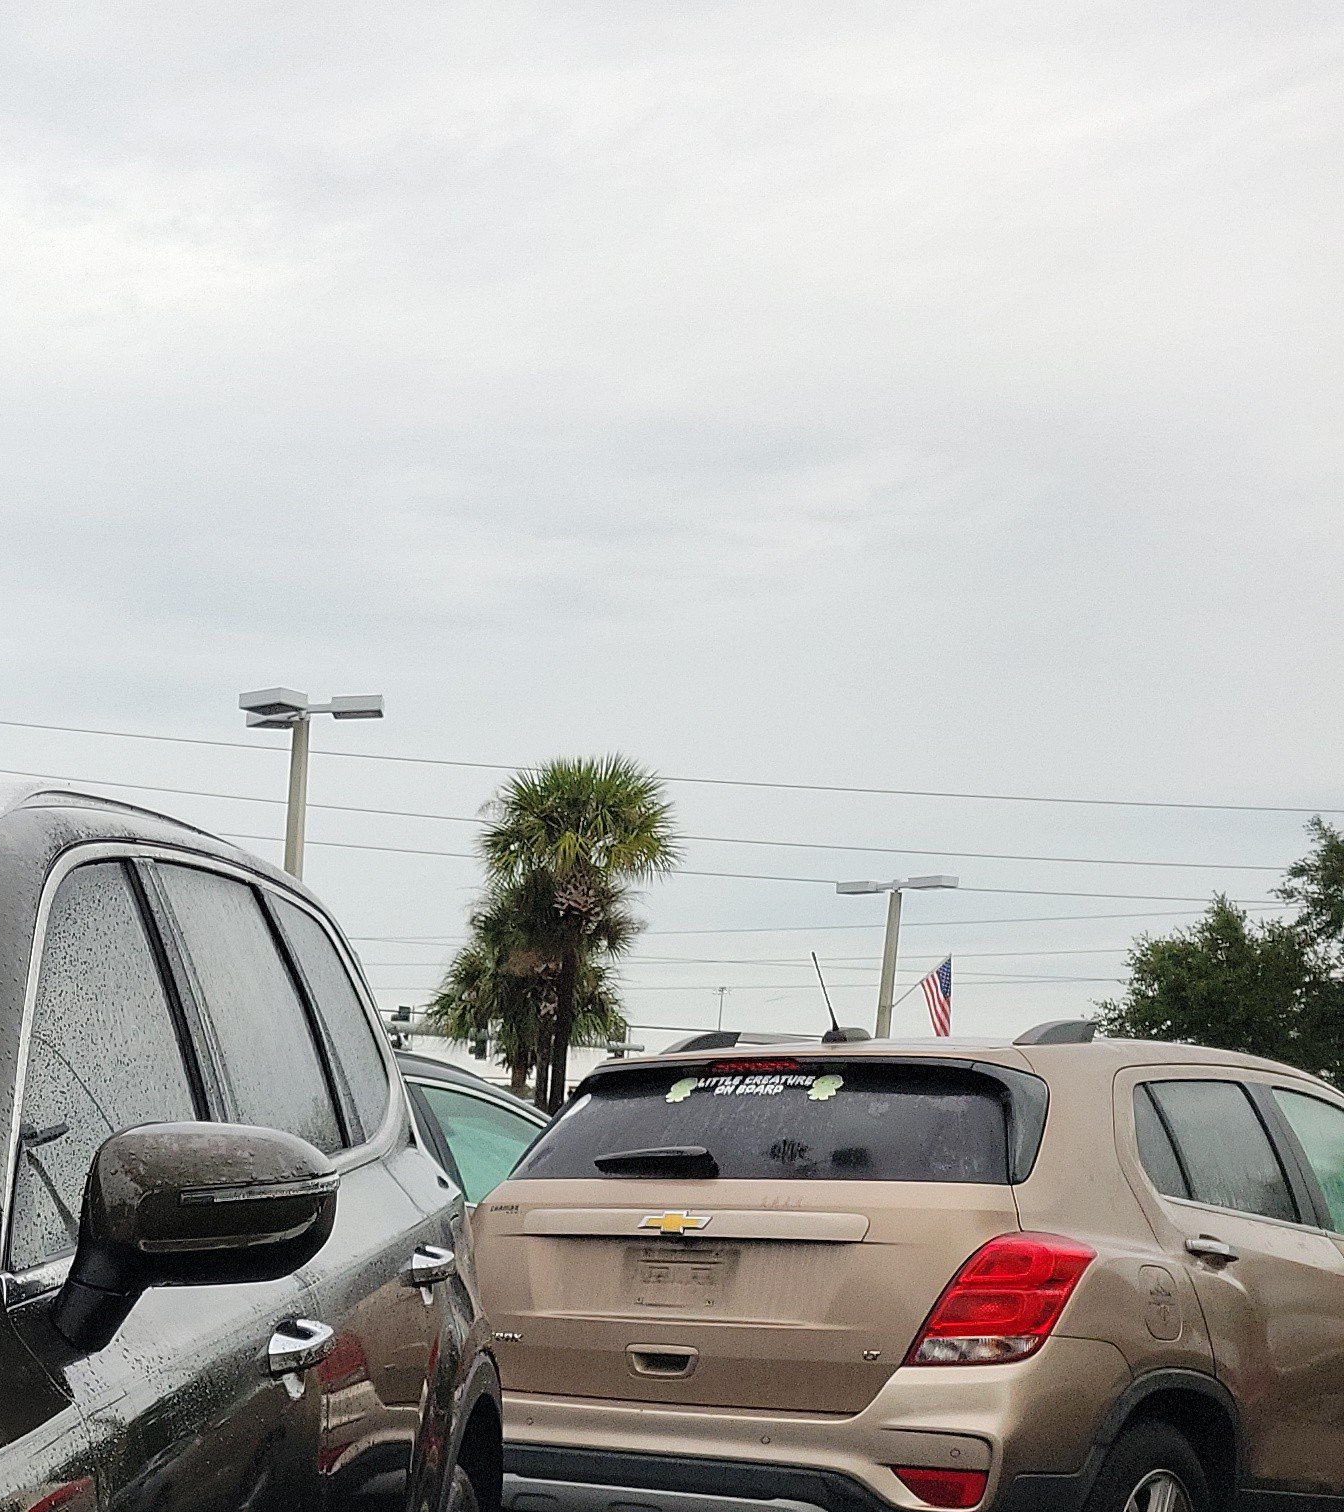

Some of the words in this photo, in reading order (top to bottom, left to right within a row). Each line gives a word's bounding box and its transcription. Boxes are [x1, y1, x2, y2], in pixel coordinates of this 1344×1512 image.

[697, 1075, 743, 1088] LITTLE
[743, 1075, 816, 1086] CREATURE
[713, 1085, 734, 1096] ON
[735, 1084, 784, 1096] BOARD
